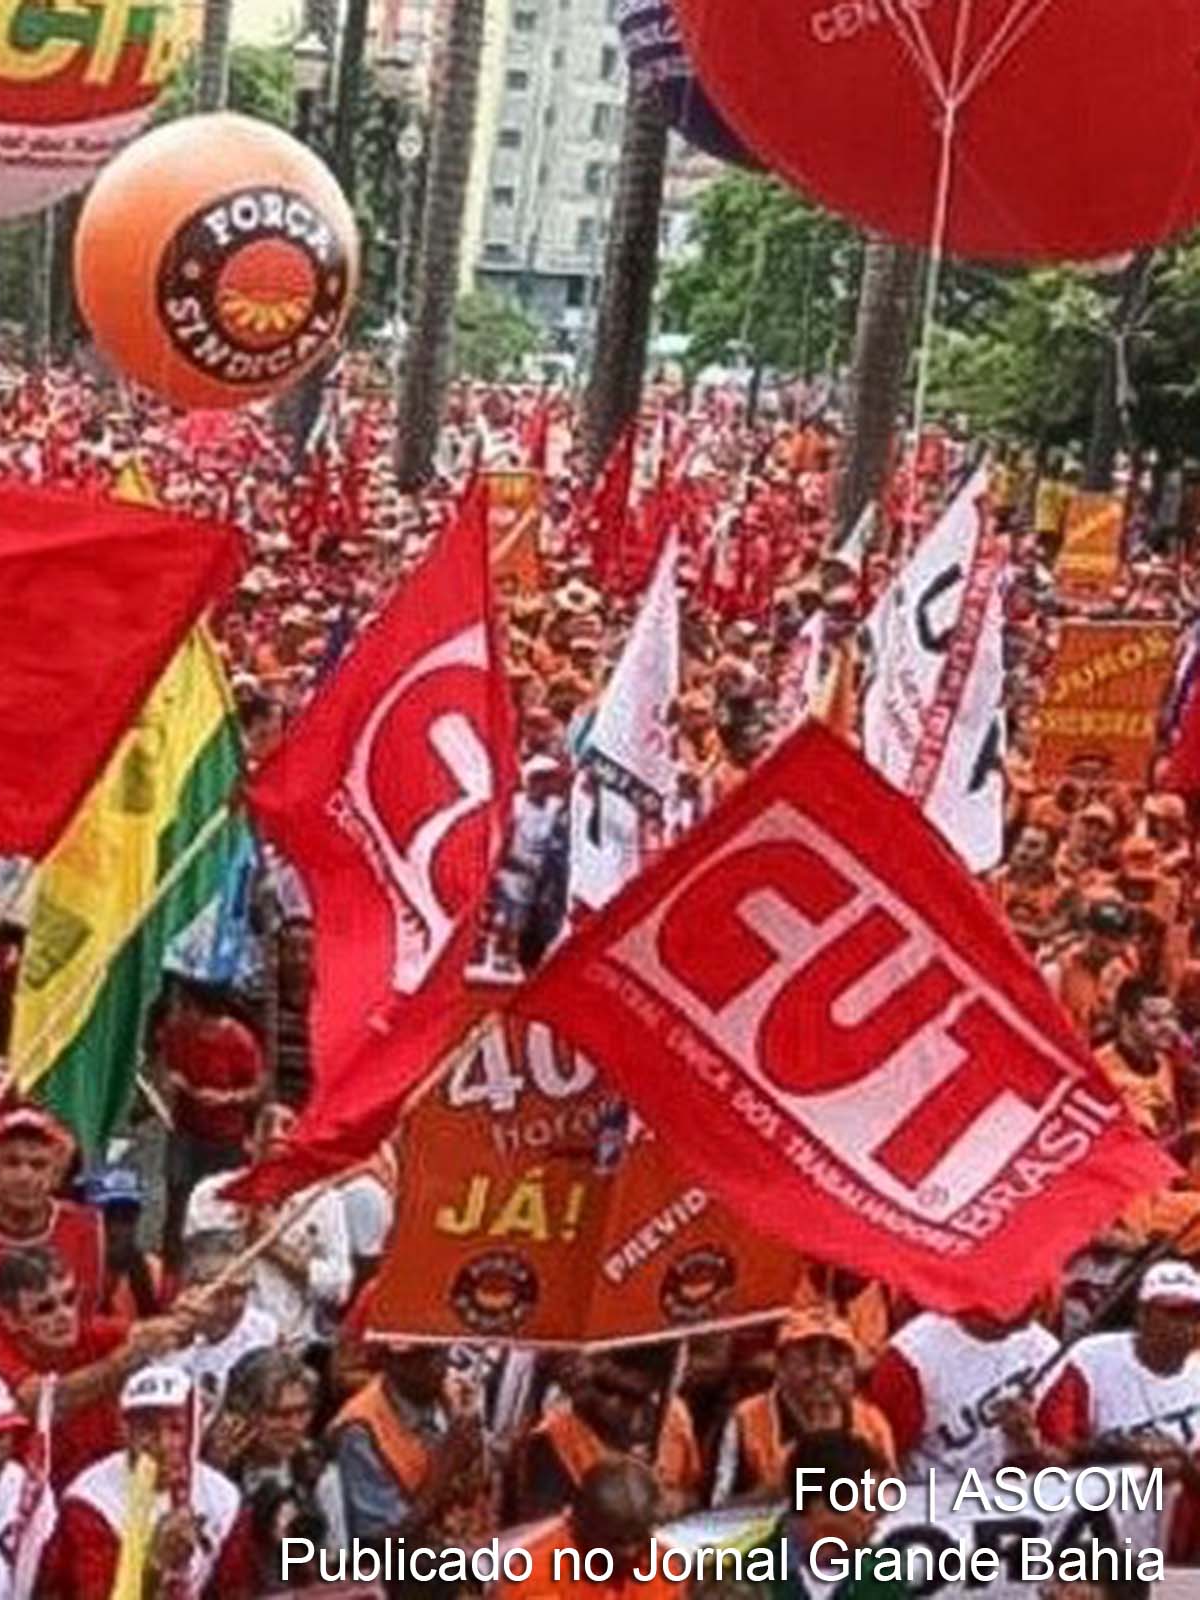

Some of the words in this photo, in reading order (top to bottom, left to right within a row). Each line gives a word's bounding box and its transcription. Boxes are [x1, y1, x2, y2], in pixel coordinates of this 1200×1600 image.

[204, 192, 332, 260] FORÇA
[166, 296, 335, 378] SINDICAL
[657, 838, 1078, 1192] CUT
[952, 1086, 1124, 1240] BRASIL
[435, 1167, 585, 1242] JÁ!
